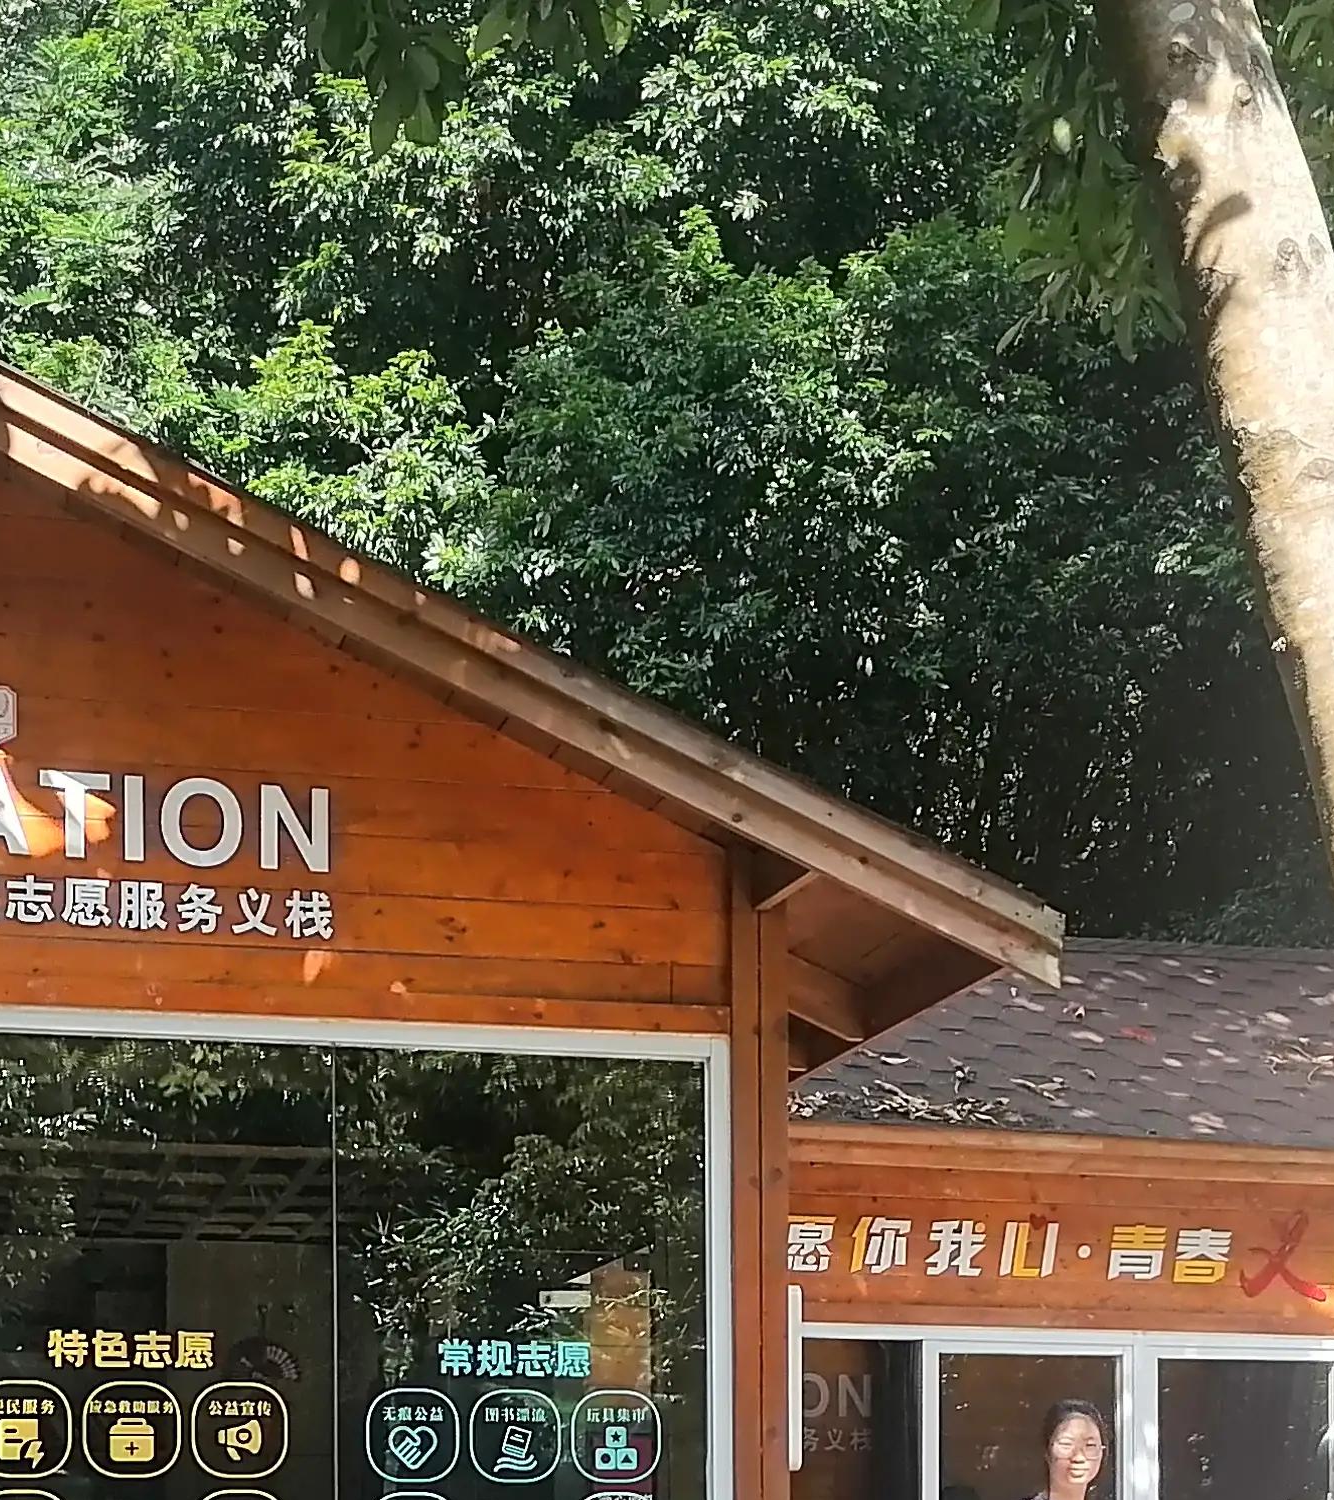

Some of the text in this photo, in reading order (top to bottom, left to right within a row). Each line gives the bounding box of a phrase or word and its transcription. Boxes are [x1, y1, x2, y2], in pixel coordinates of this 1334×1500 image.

[47, 1329, 215, 1369] 特色志愿
[438, 1338, 592, 1378] 常规志愿
[208, 1400, 272, 1417] 公益宣传
